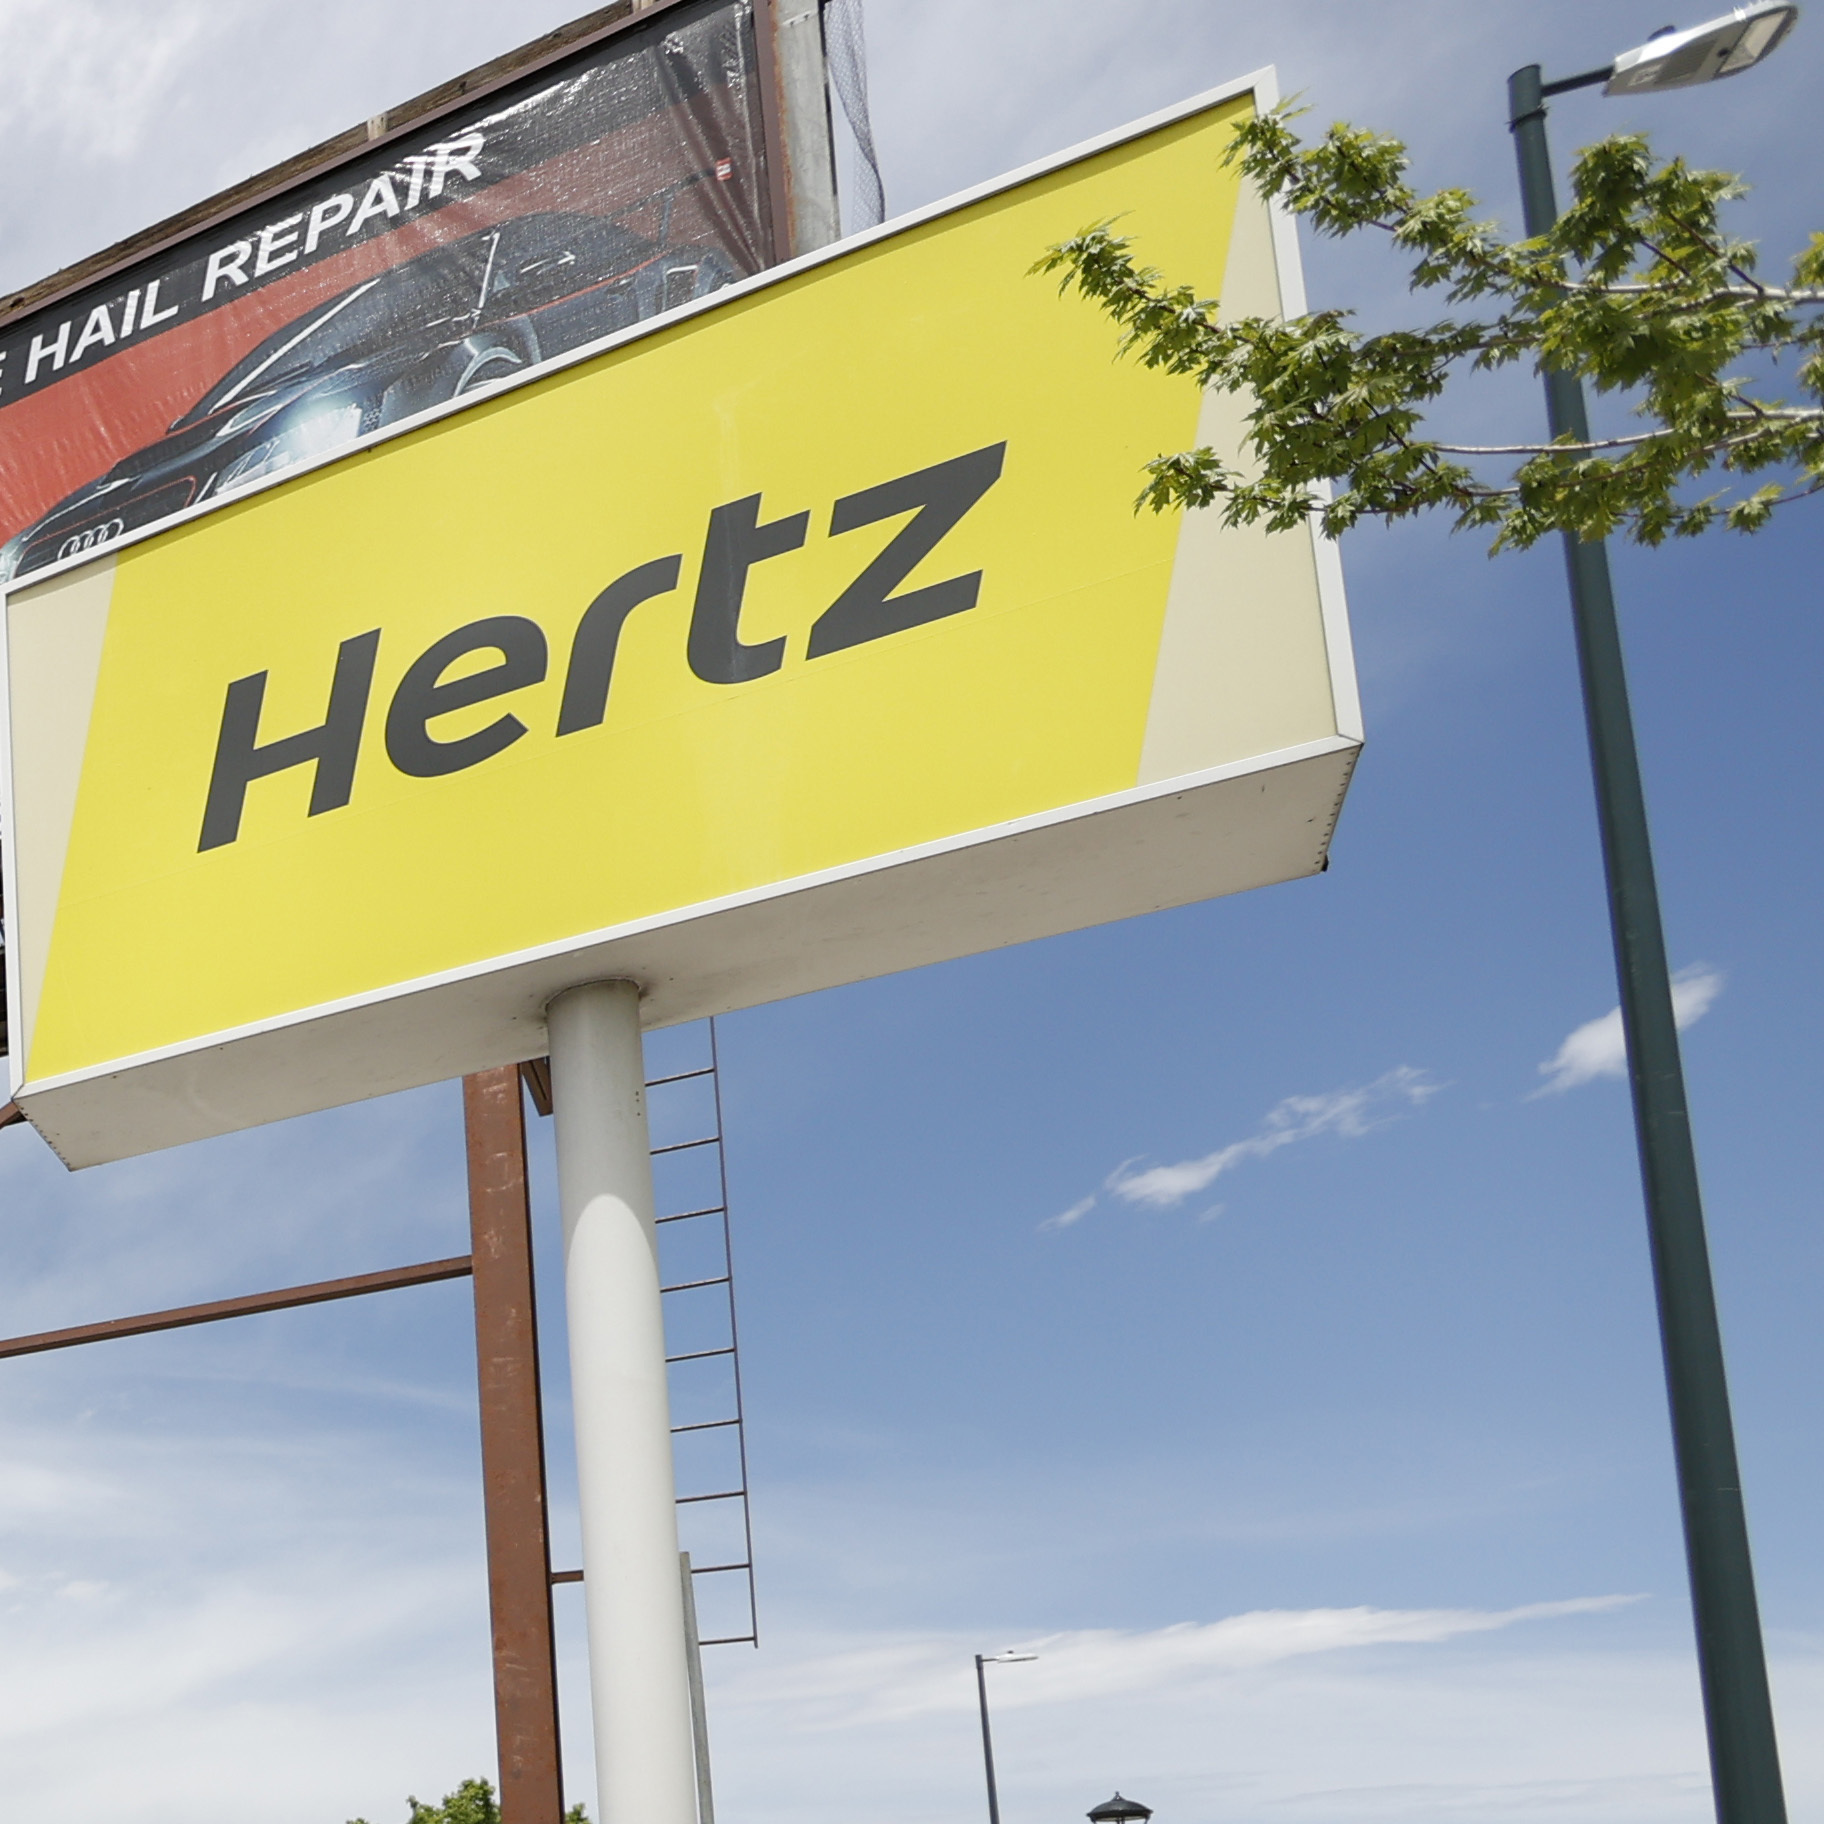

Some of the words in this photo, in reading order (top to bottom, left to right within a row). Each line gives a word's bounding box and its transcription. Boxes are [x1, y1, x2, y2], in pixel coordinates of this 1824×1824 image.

[22, 278, 180, 384] HAIL
[202, 131, 486, 303] REPAIR
[196, 440, 1008, 854] Hertz
